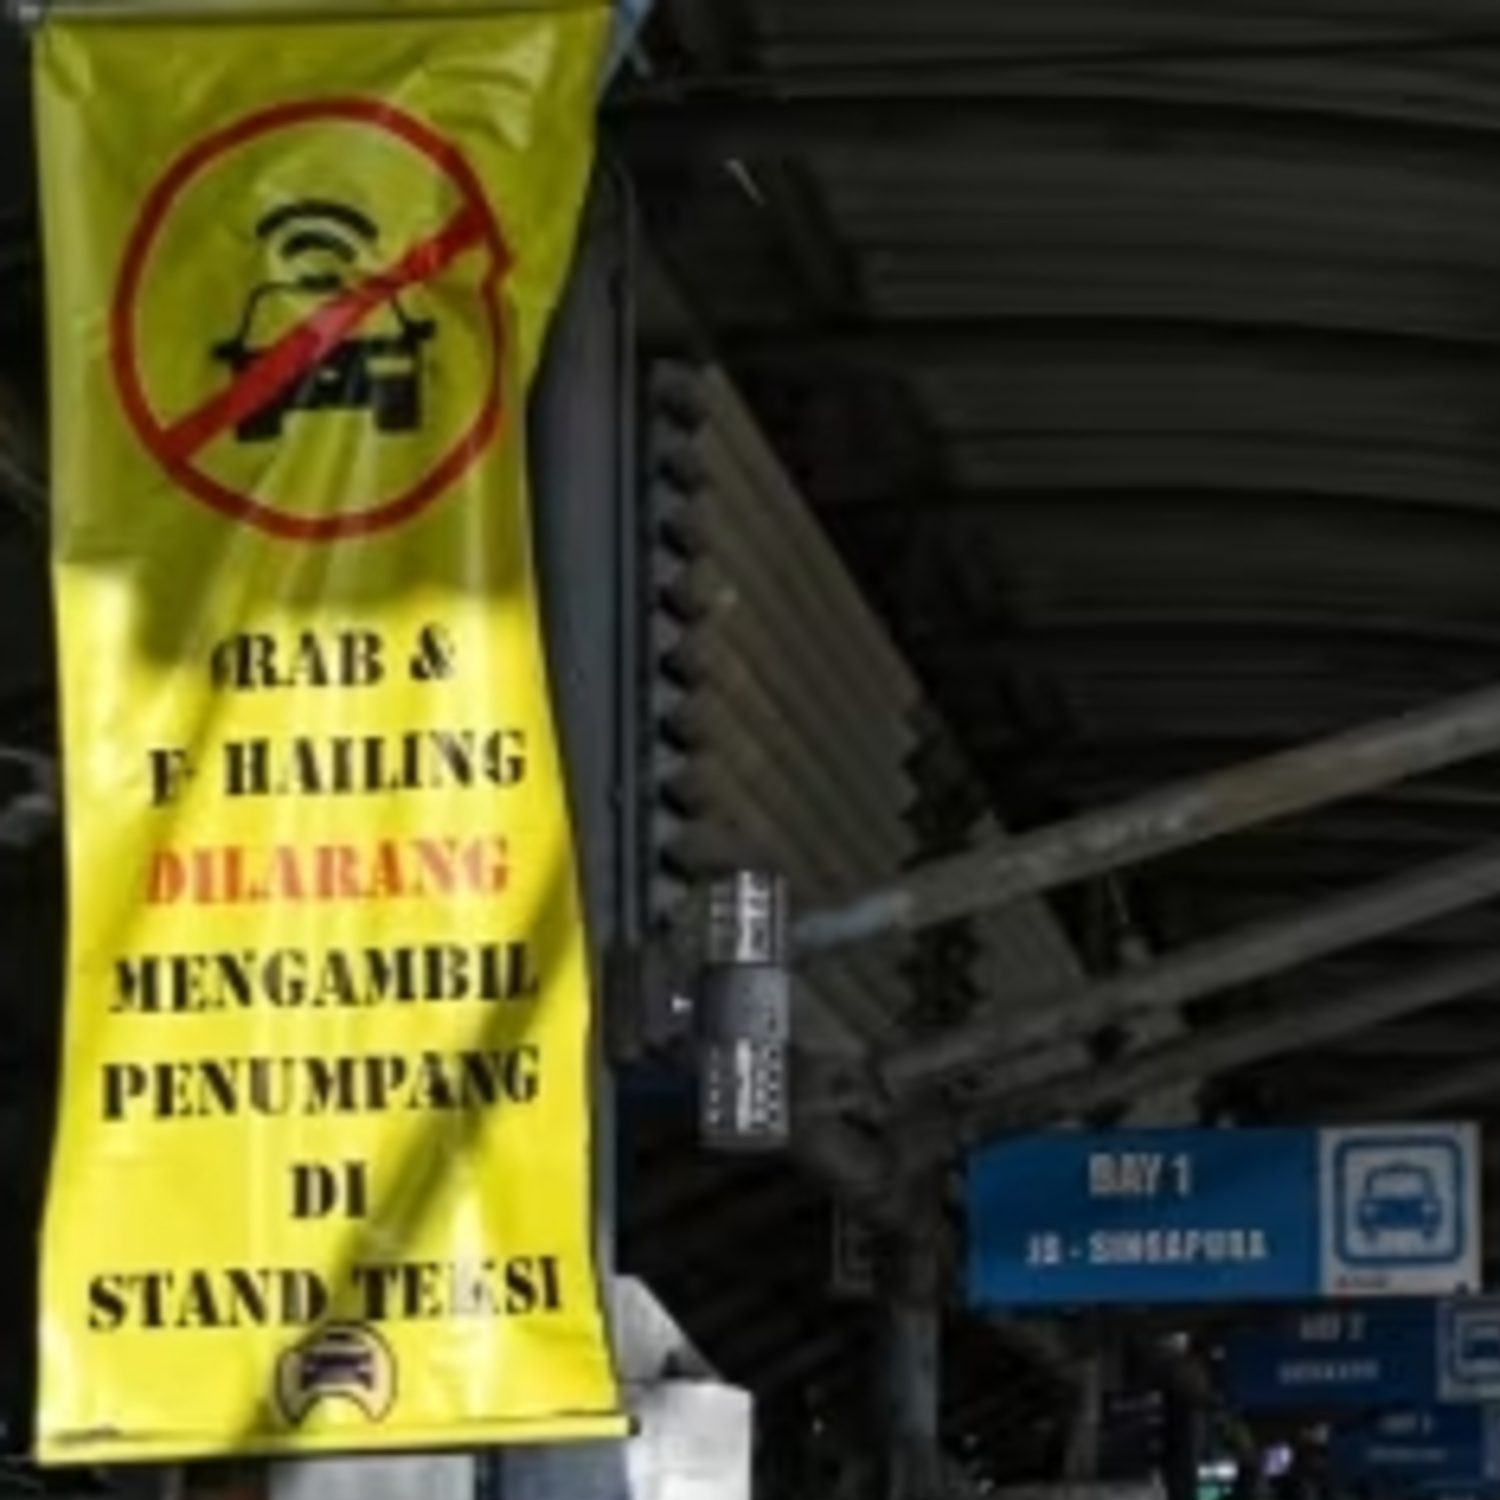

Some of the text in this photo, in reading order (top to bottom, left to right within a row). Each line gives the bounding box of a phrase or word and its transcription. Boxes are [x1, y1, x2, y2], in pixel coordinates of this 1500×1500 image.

[409, 623, 457, 683] &
[223, 730, 527, 797] HAILING
[142, 836, 510, 904] DILARANG
[110, 941, 539, 1014] MENGAMBIL
[101, 1045, 540, 1121] PENUMPANG
[289, 1161, 368, 1219] DI
[1088, 1153, 1192, 1198] BAY 1
[88, 1267, 328, 1331] STAND
